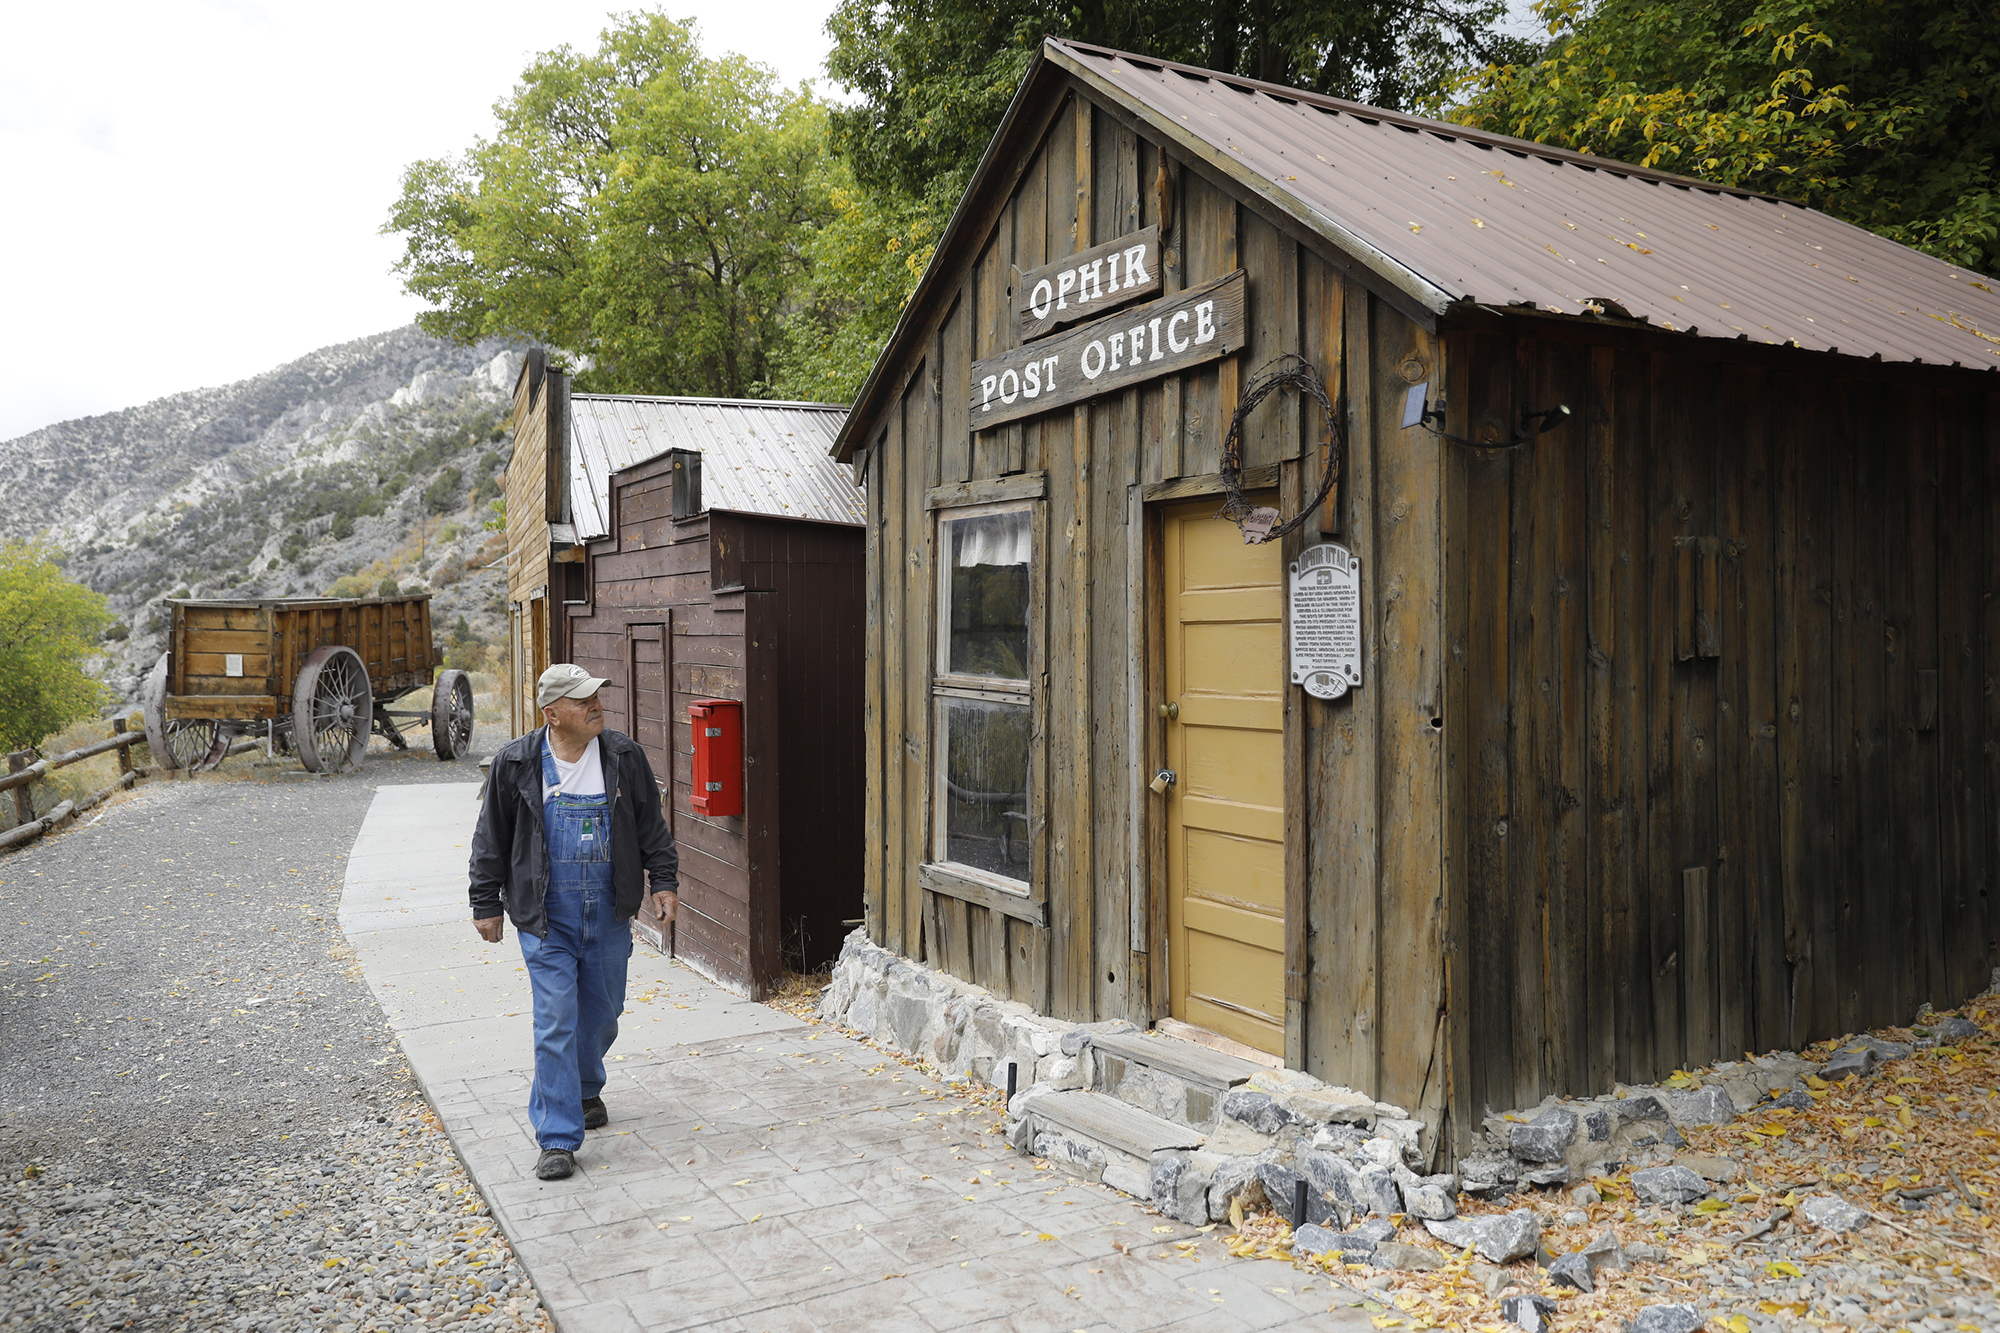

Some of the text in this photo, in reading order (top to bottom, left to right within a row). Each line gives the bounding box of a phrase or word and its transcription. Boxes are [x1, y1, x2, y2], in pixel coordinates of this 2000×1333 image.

[1030, 243, 1151, 320] OPHIR
[980, 300, 1216, 412] POST OFFICE
[1301, 546, 1346, 571] OPHIR UTAH
